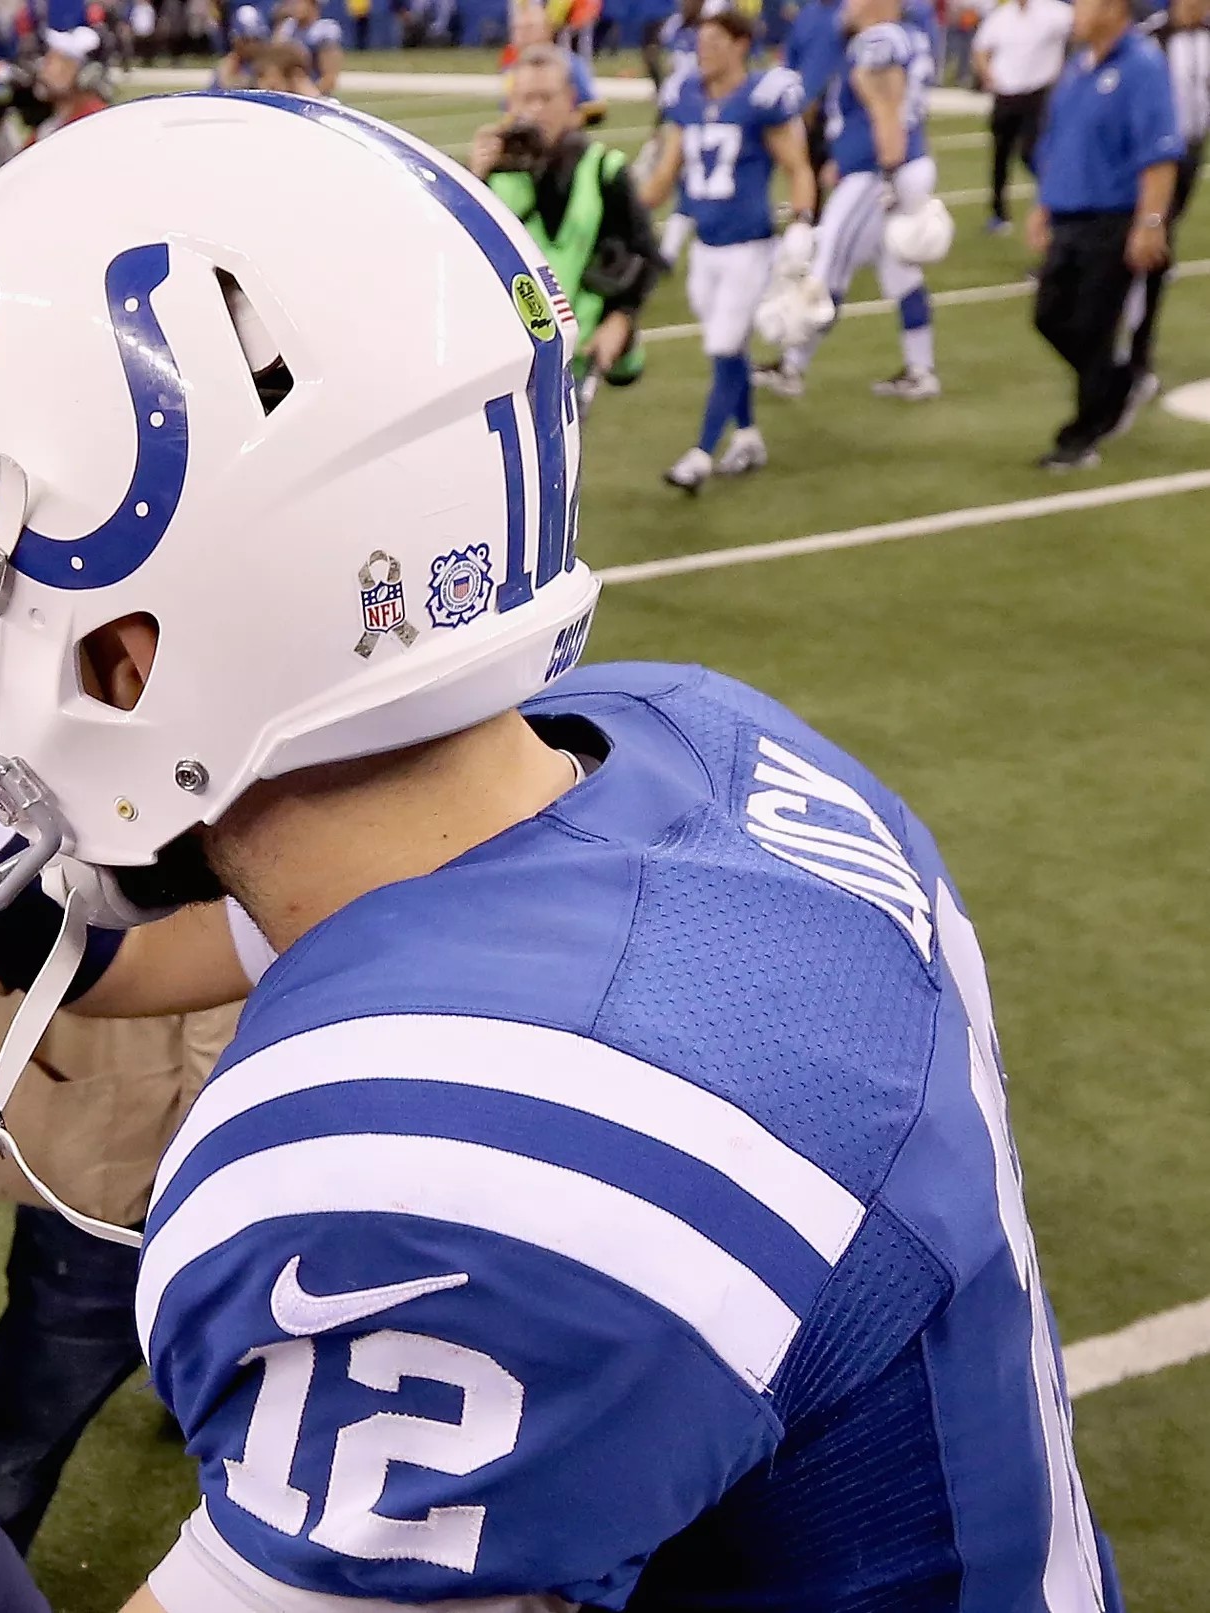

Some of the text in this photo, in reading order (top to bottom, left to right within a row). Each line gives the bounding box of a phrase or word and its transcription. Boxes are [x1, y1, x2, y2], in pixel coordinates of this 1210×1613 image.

[683, 122, 742, 200] 17
[367, 601, 402, 628] NFL
[746, 736, 933, 963] LUCK
[222, 1329, 525, 1575] 12
